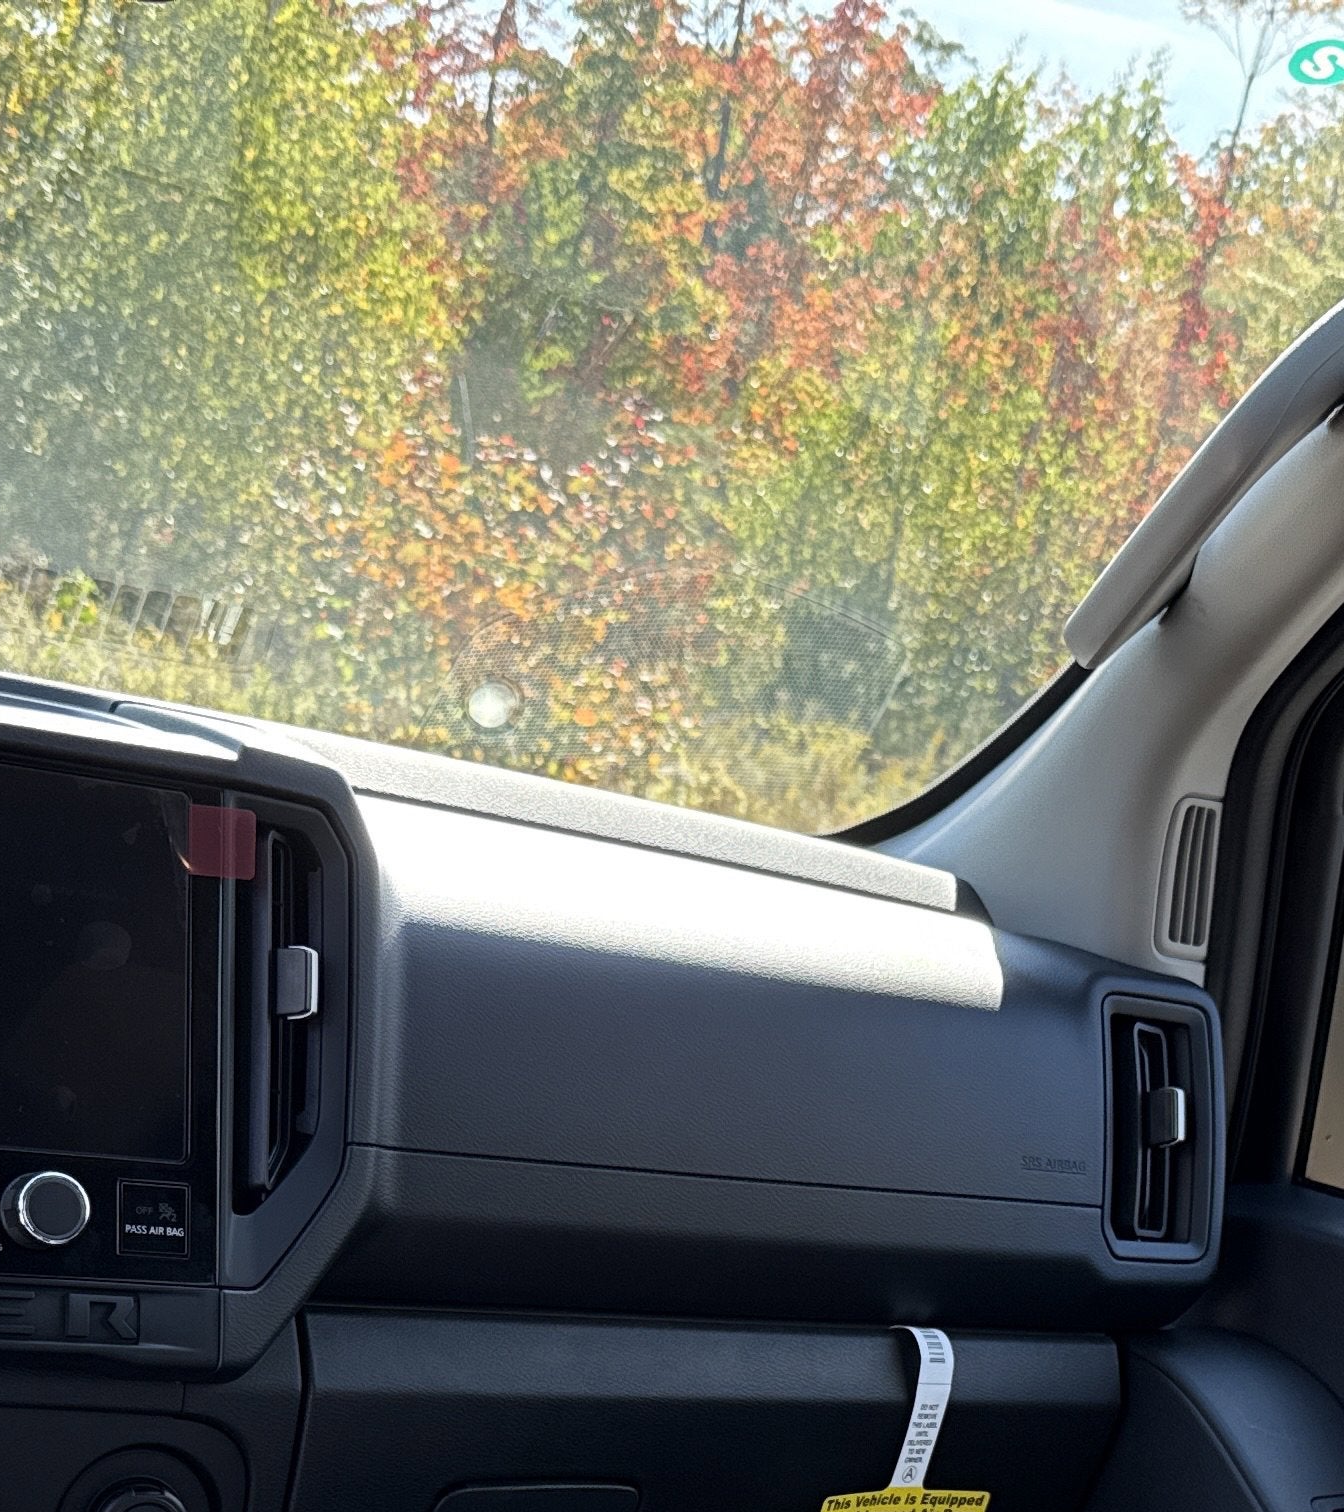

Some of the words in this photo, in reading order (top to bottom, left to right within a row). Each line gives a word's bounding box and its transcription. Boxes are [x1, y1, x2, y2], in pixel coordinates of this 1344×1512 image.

[125, 1224, 147, 1236] PASS
[149, 1225, 164, 1236] AIR
[164, 1226, 185, 1238] BAG
[826, 1498, 851, 1511] This
[856, 1494, 900, 1508] Vehicle
[920, 1493, 985, 1508] Equipped
